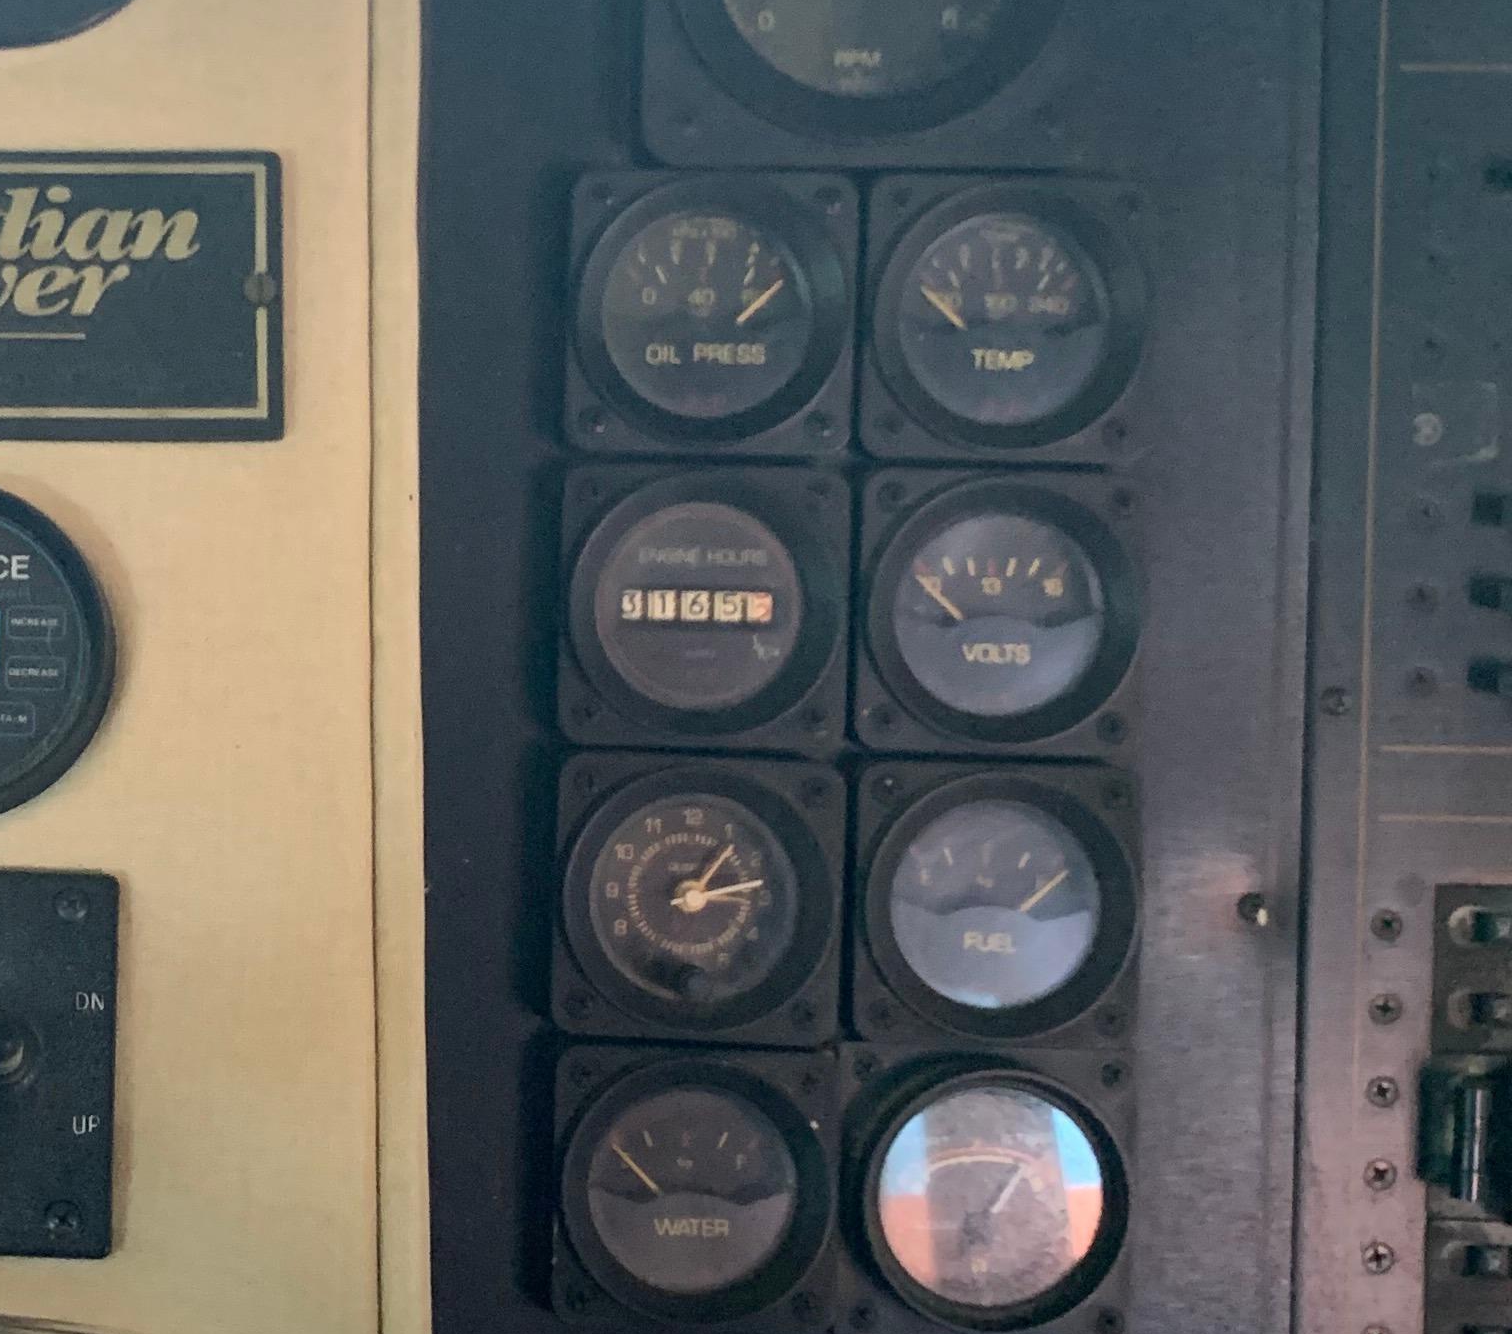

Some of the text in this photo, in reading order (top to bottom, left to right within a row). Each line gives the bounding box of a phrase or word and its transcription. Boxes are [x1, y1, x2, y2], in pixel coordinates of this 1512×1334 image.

[645, 342, 766, 366] OIL PRESS
[970, 347, 1035, 371] TEMP
[706, 548, 768, 566] HOURS
[10, 617, 59, 627] INCREASE
[962, 642, 1031, 666] VOLTS
[7, 667, 59, 678] DECREASE
[644, 817, 663, 835] 11
[683, 808, 704, 826] 12
[614, 843, 635, 861] 10
[962, 930, 1017, 955] FUEL
[74, 992, 105, 1011] DN
[72, 1115, 101, 1135] UP
[653, 1217, 730, 1238] WATER
